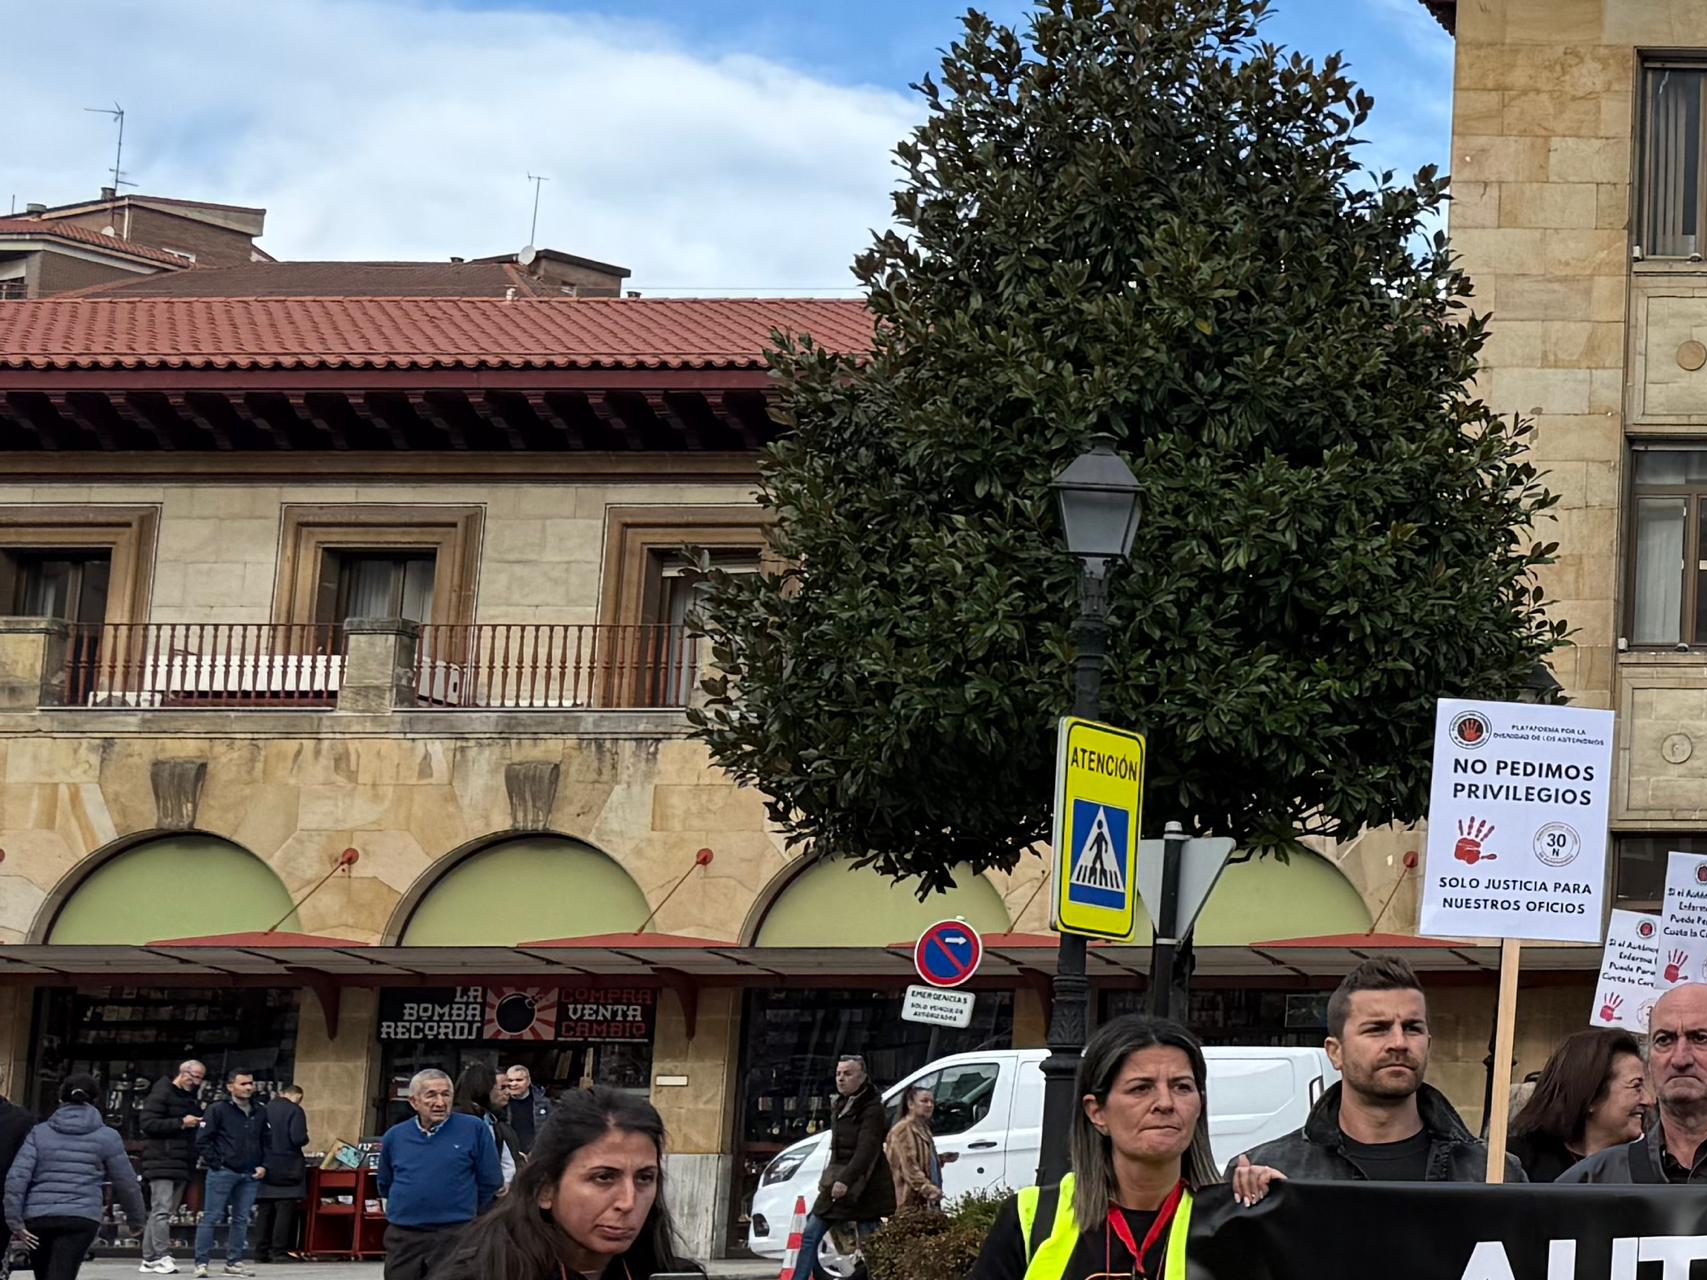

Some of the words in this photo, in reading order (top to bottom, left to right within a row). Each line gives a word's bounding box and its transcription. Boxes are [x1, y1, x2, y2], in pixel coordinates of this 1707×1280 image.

[1070, 745, 1138, 782] ATENCIÓN
[1453, 758, 1487, 775] NO
[1496, 759, 1594, 782] PEDIMOS
[1453, 783, 1592, 805] PRIVILEGIOS
[1547, 833, 1566, 848] 30
[1439, 876, 1480, 889] SOLO
[1484, 878, 1549, 893] JUSTICIA
[1553, 882, 1592, 895] PARA
[1442, 897, 1521, 911] NUESTROS
[1526, 901, 1585, 915] OFICIOS
[454, 986, 483, 1002] LA
[561, 987, 652, 1004] COMPRA
[911, 990, 968, 1004] EMERGENCIAS
[402, 1003, 482, 1021] BOMBA
[568, 1004, 642, 1021] VENTA
[380, 1021, 481, 1040] RECORDS
[561, 1022, 645, 1037] CAMBIO
